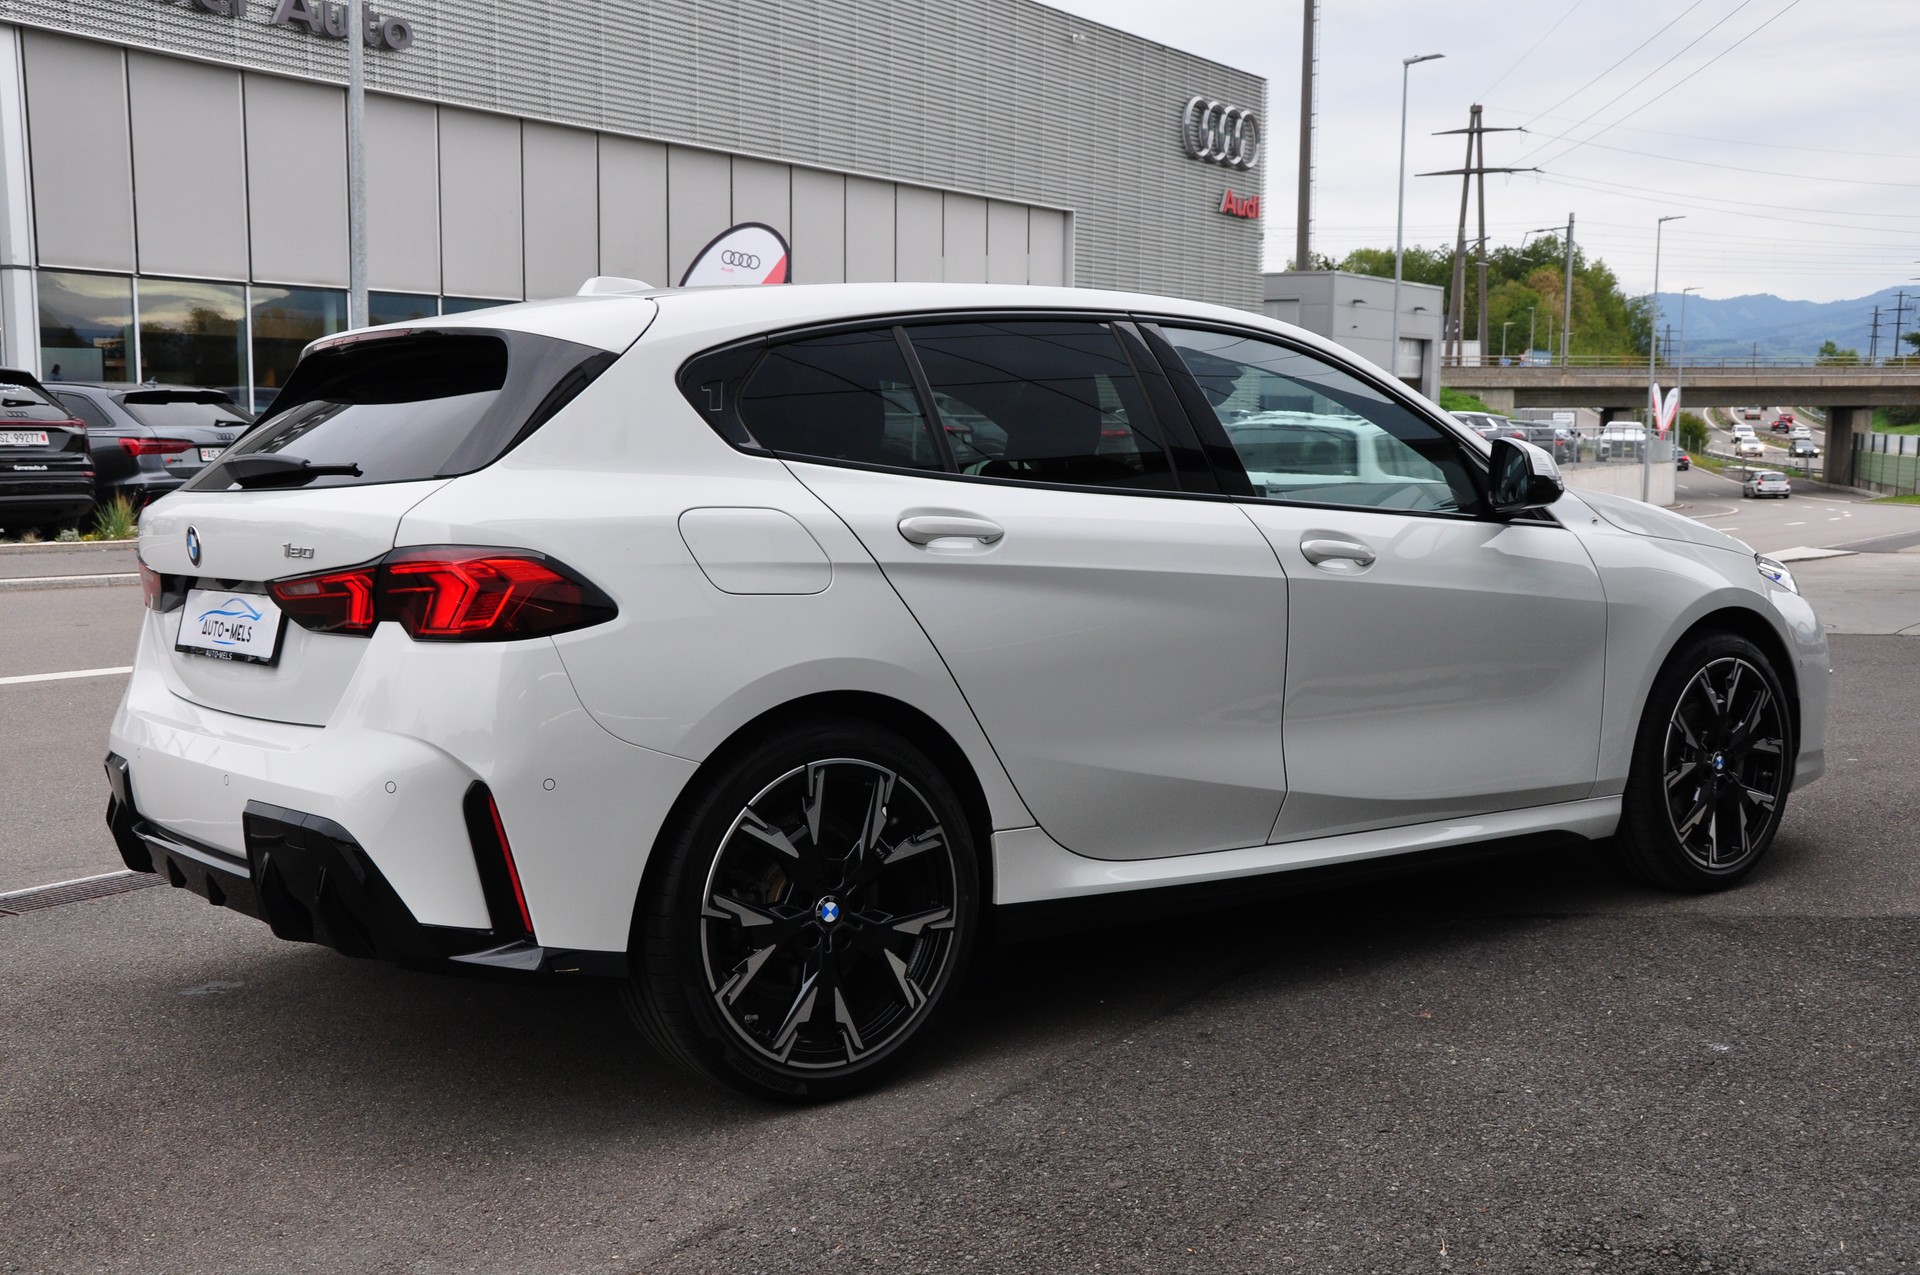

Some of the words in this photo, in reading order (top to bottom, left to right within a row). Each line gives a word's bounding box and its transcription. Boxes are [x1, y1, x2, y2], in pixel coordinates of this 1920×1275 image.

[270, 0, 414, 50] Auto
[1220, 187, 1260, 219] Audi
[282, 543, 315, 559] 120
[201, 619, 252, 642] AUTO-MELS
[205, 650, 233, 660] AUTO-MELS
